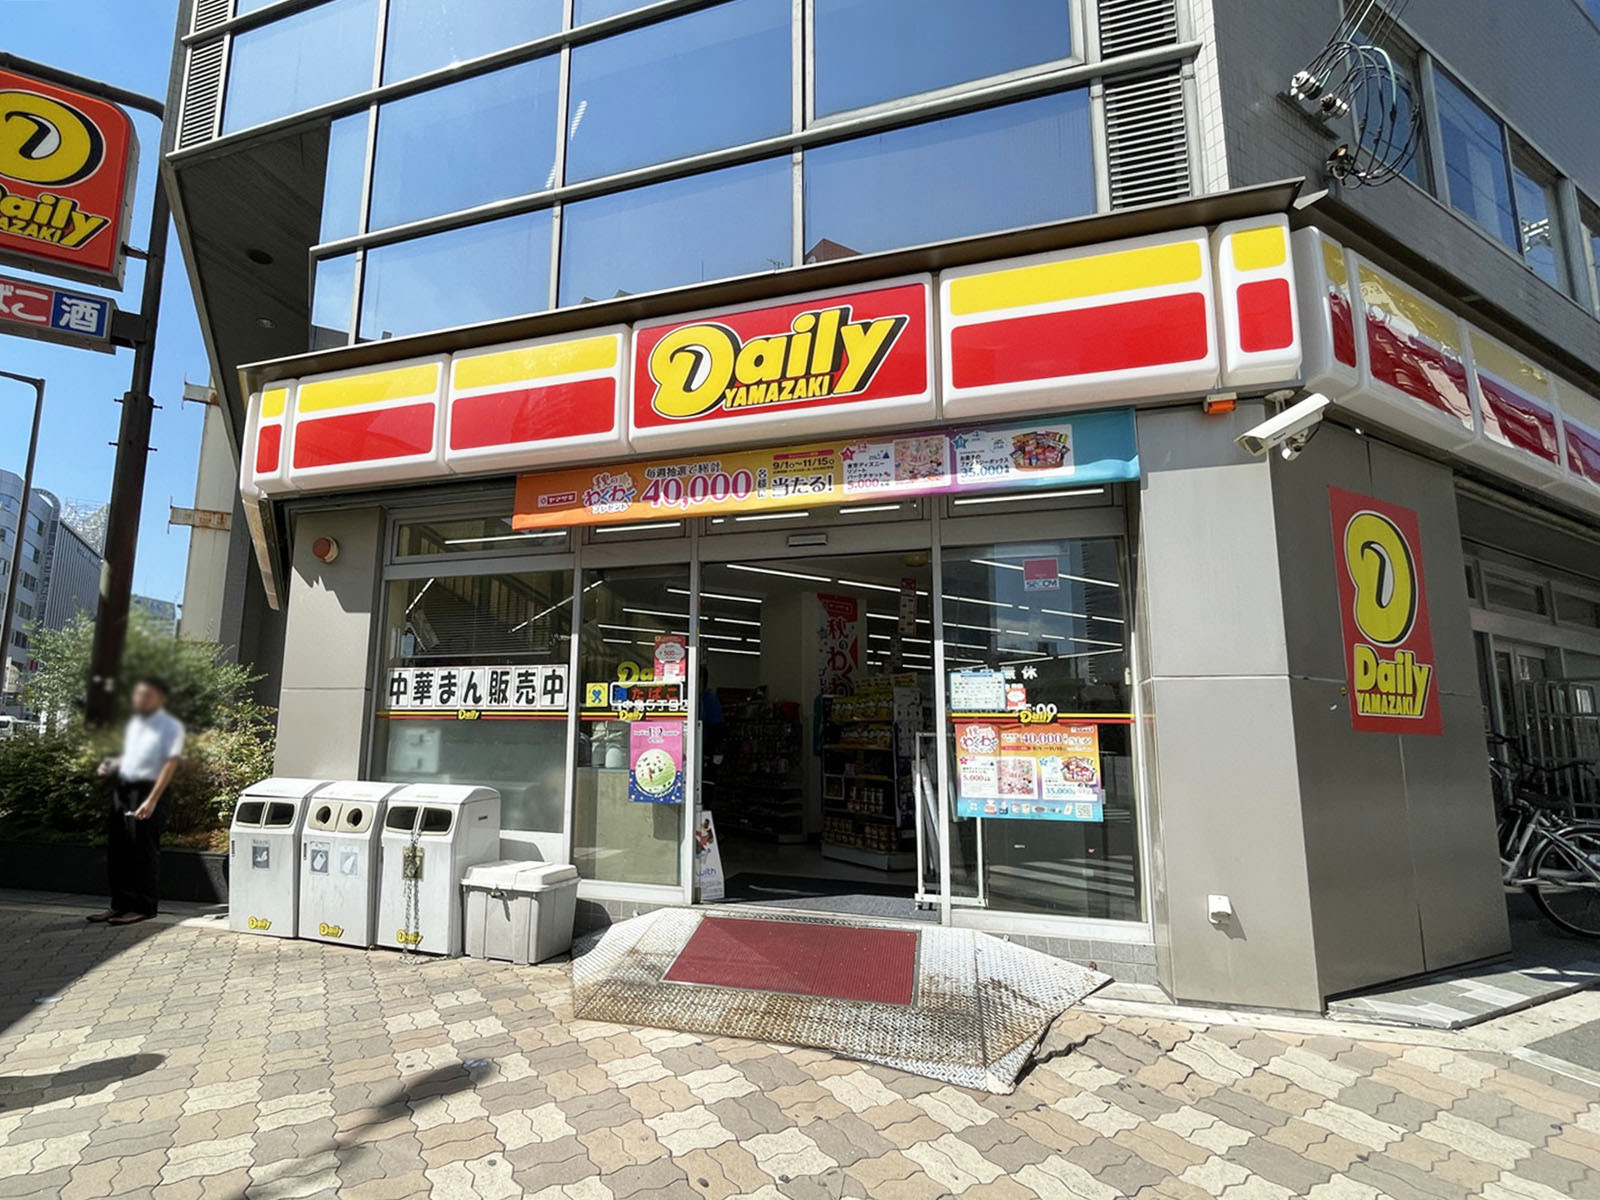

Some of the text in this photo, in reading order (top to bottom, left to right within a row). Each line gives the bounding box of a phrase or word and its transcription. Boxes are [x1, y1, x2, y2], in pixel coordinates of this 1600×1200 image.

[0, 183, 110, 247] aily
[60, 297, 100, 332] 酒
[650, 308, 905, 417] Daily
[724, 375, 830, 408] YAMAZAKI
[584, 486, 636, 506] わくわく
[641, 469, 753, 507] 40,000
[388, 668, 565, 705] 中華まん販売中
[1355, 645, 1432, 716] Daily
[458, 709, 480, 720] Daily
[618, 709, 644, 721] Daily
[1358, 692, 1413, 714] YAMAZAKI
[1019, 711, 1054, 723] Daily
[249, 917, 272, 930] Daily
[319, 922, 344, 938] Daily
